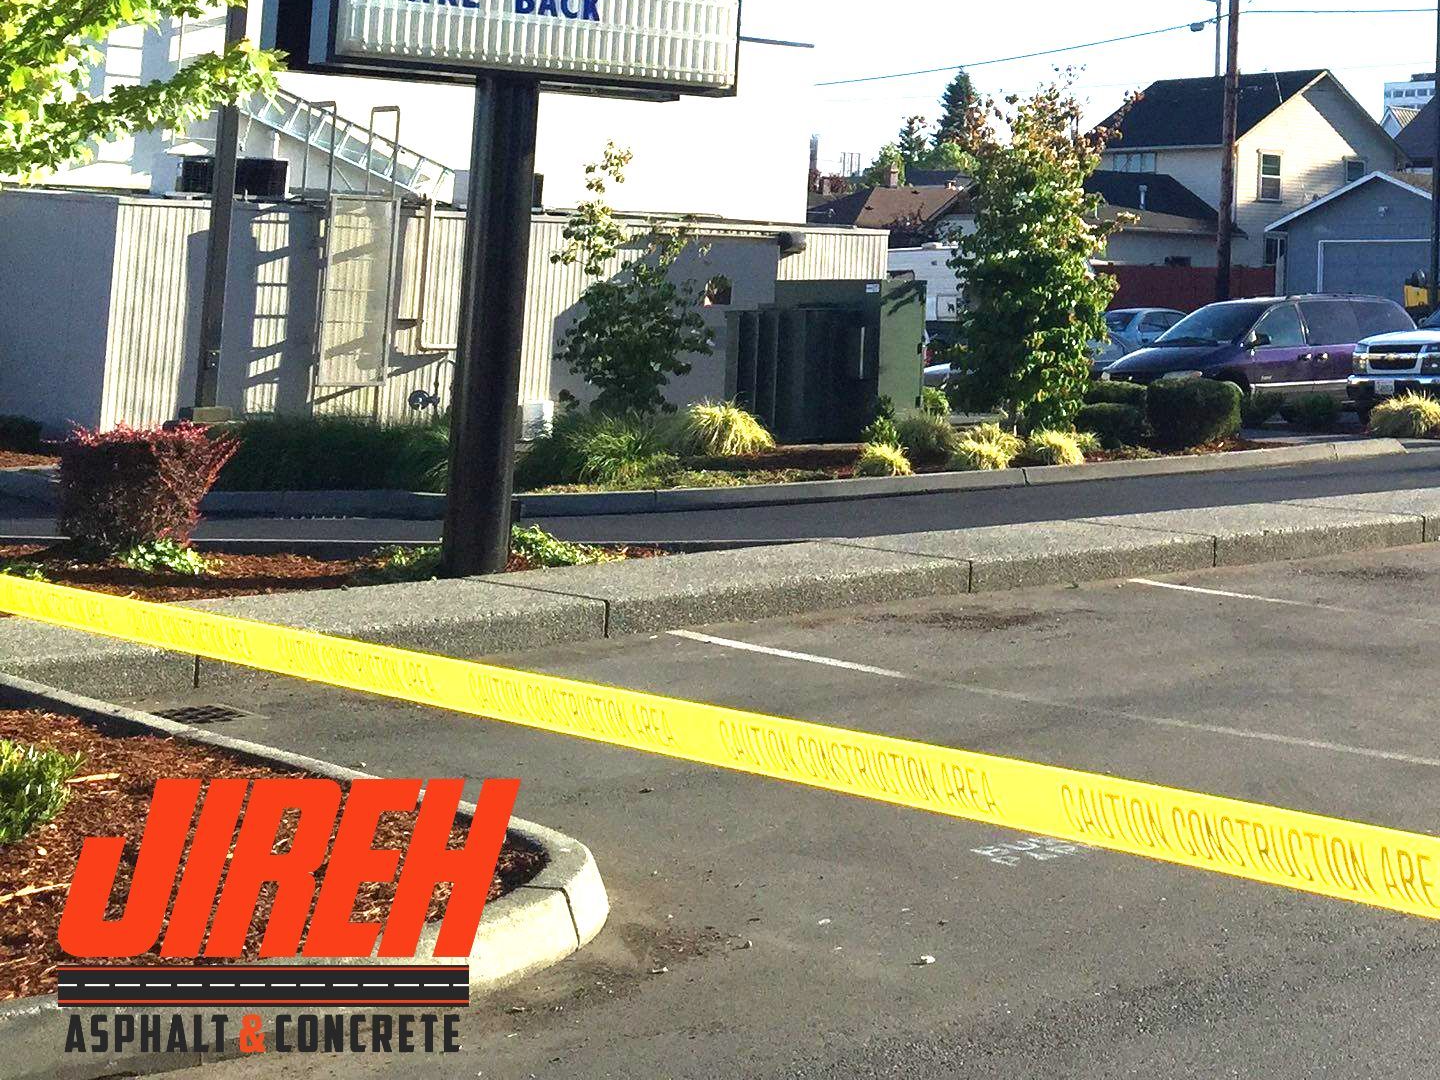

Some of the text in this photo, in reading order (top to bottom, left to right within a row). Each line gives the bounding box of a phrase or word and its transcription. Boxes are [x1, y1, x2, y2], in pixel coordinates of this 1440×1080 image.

[718, 719, 1004, 817] CAUTION CONSTRUCTION AREA
[1061, 784, 1171, 849] CAUTION
[1171, 807, 1377, 896] CONSTRUCTION
